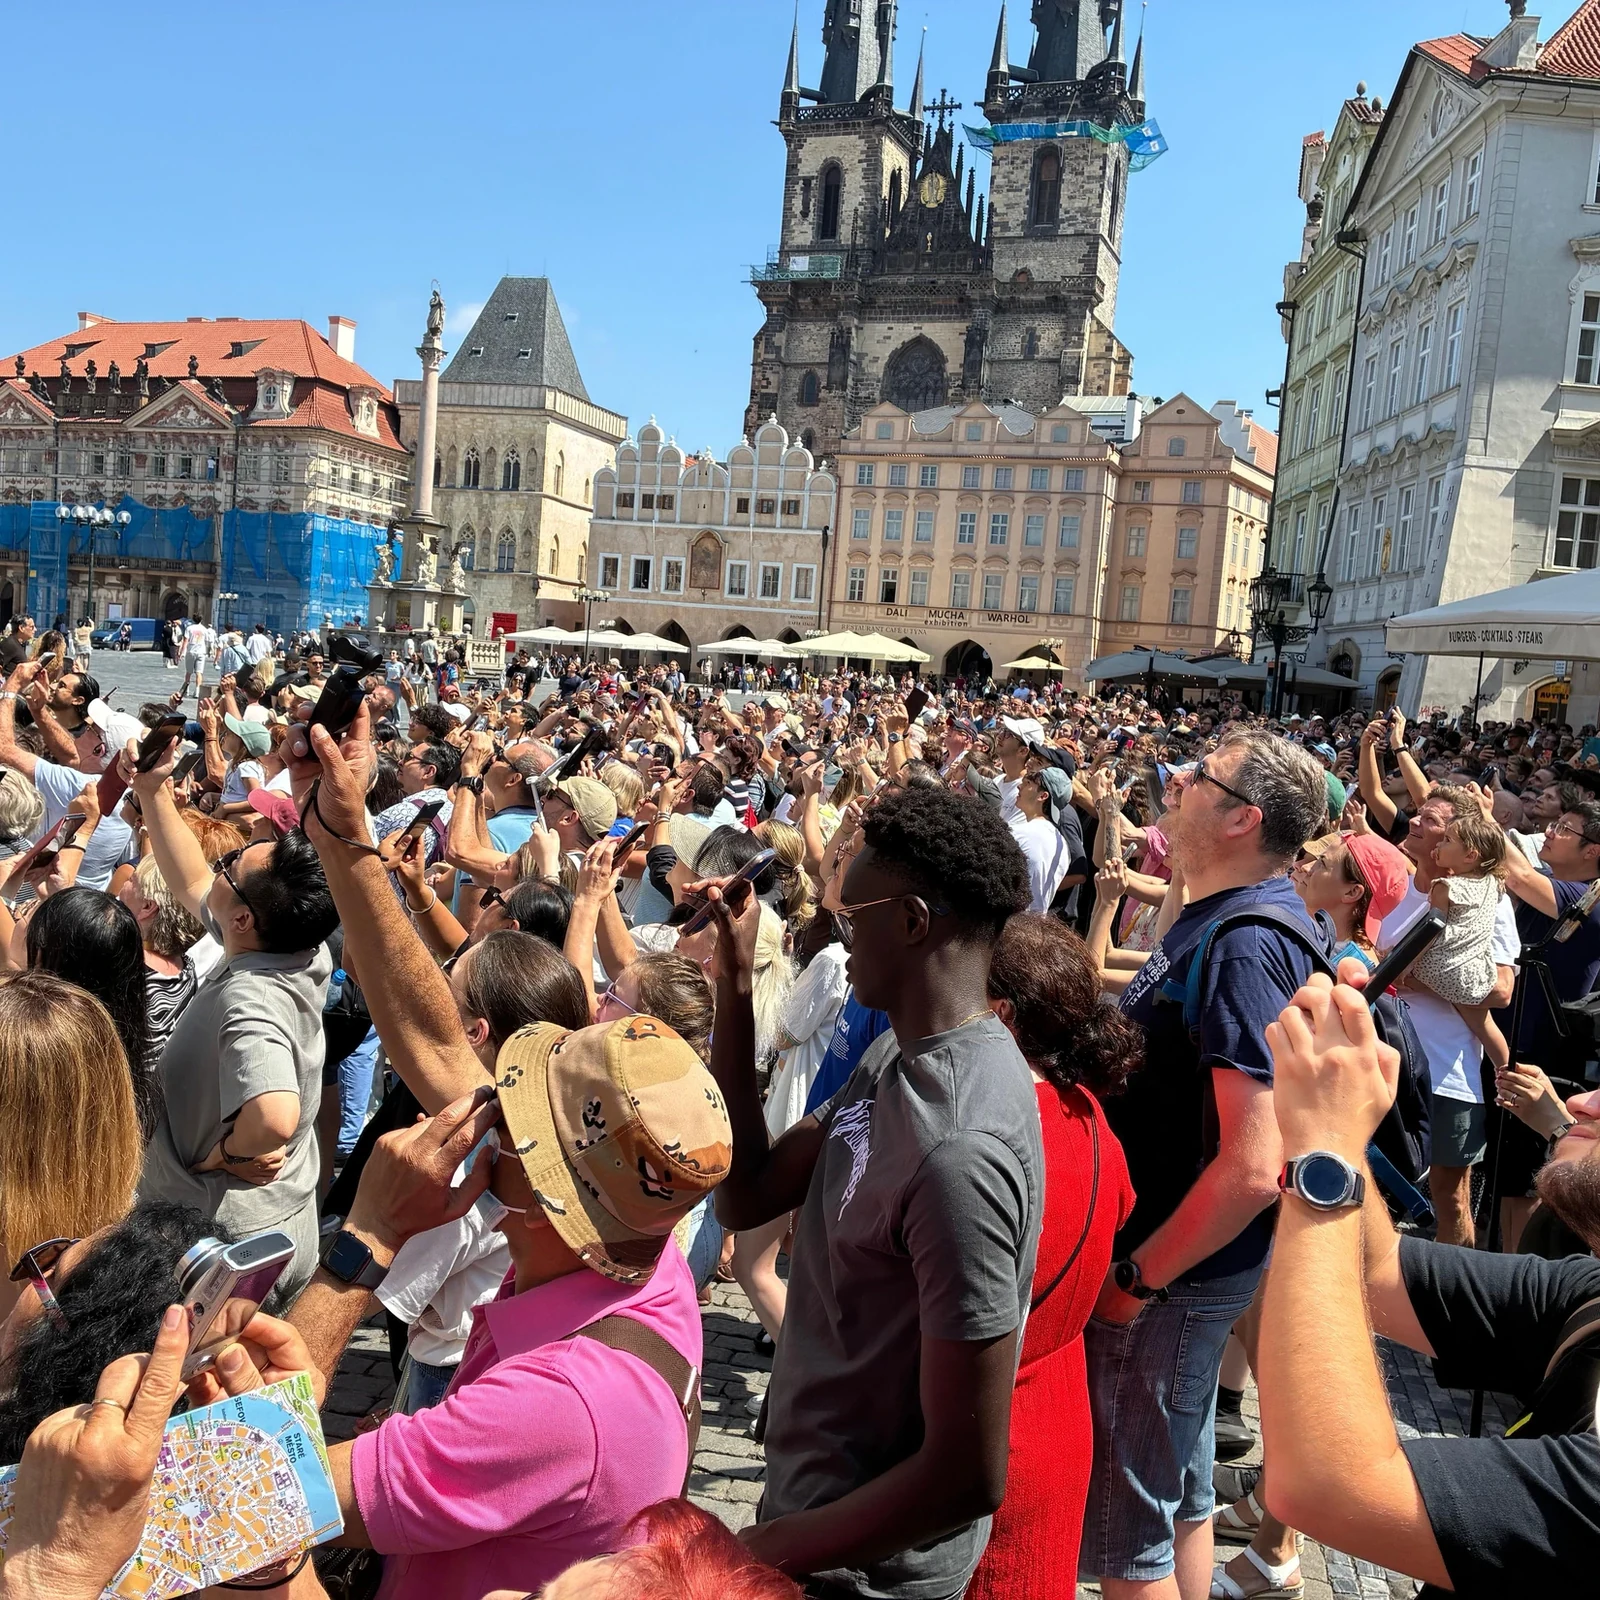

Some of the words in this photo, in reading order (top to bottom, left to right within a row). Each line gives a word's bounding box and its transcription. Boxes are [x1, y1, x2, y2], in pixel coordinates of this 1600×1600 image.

[1425, 486, 1455, 598] HOTEL
[928, 610, 964, 620] MUCHA
[988, 613, 1030, 624] WARHOL
[841, 624, 884, 632] RESTAURANT
[1481, 630, 1513, 642] COKTAILS
[285, 1436, 297, 1464] MĚSTO
[294, 1432, 306, 1459] STARÉ
